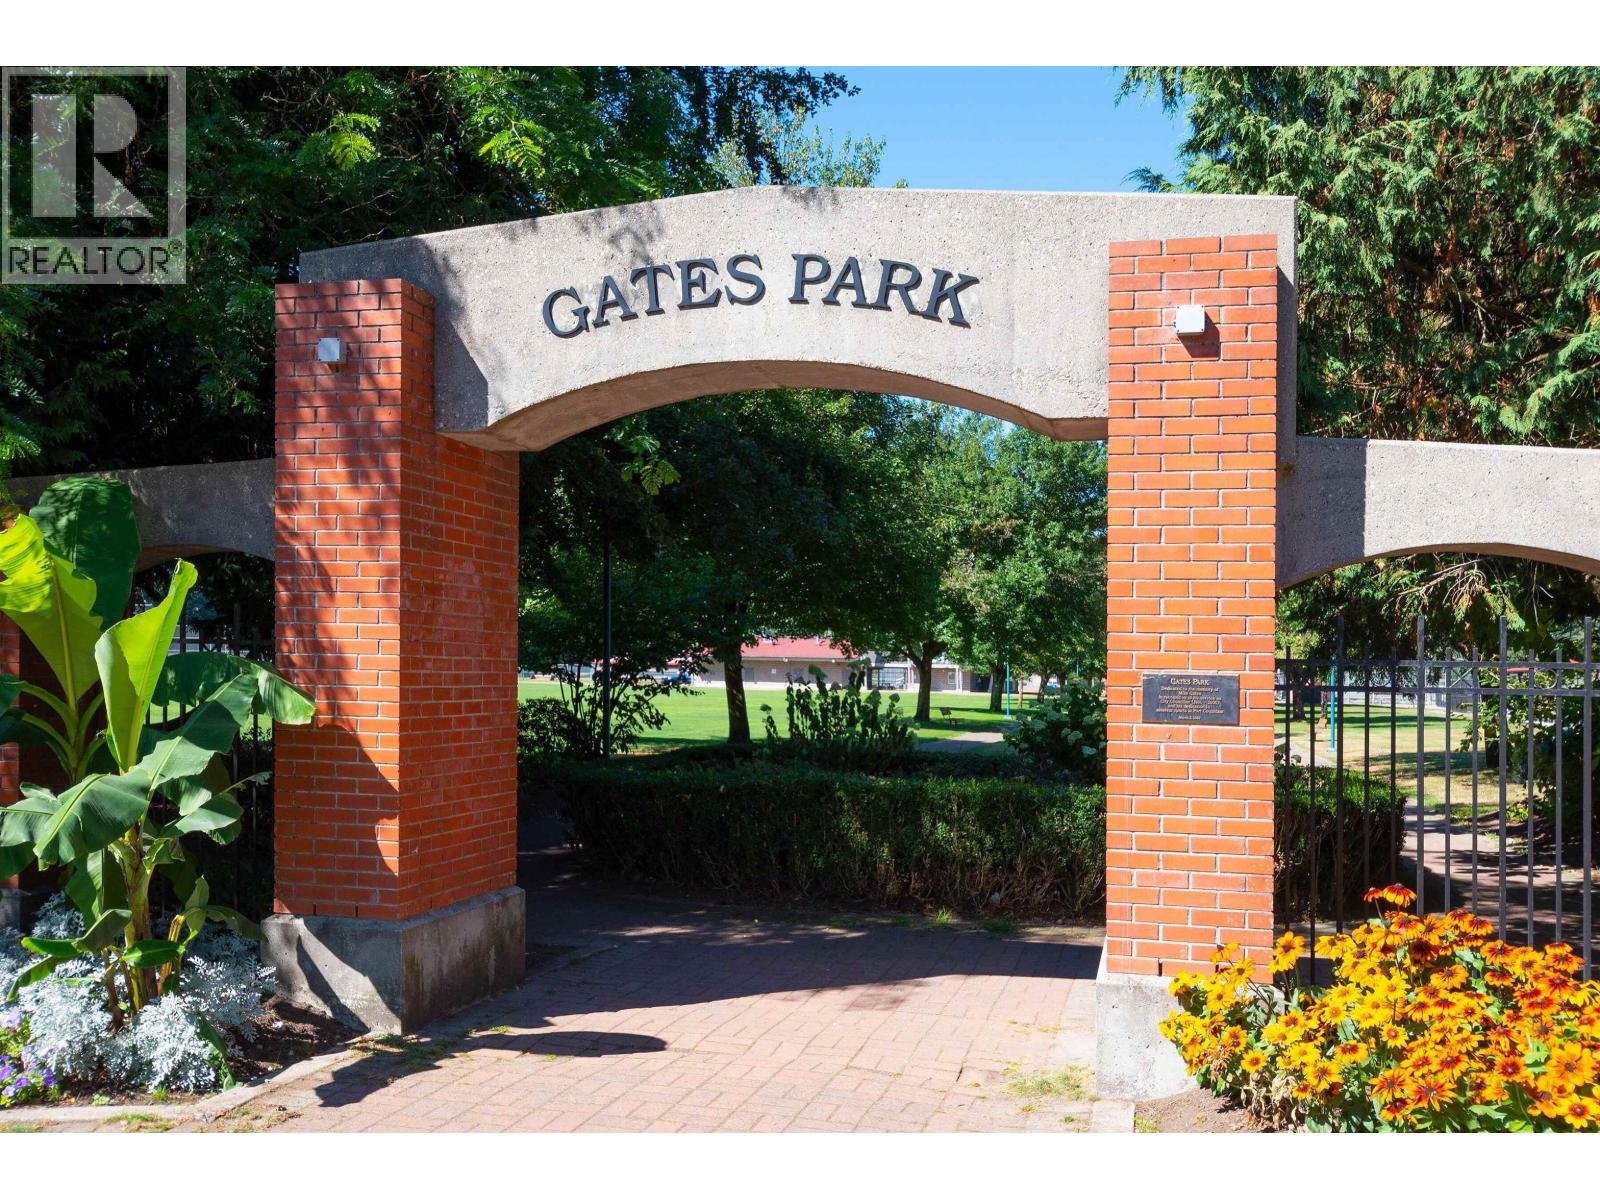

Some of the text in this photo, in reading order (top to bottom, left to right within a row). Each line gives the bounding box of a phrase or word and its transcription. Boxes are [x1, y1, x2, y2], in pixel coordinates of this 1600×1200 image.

[542, 254, 980, 339] GATES PARK
[1192, 678, 1210, 686] PARK
